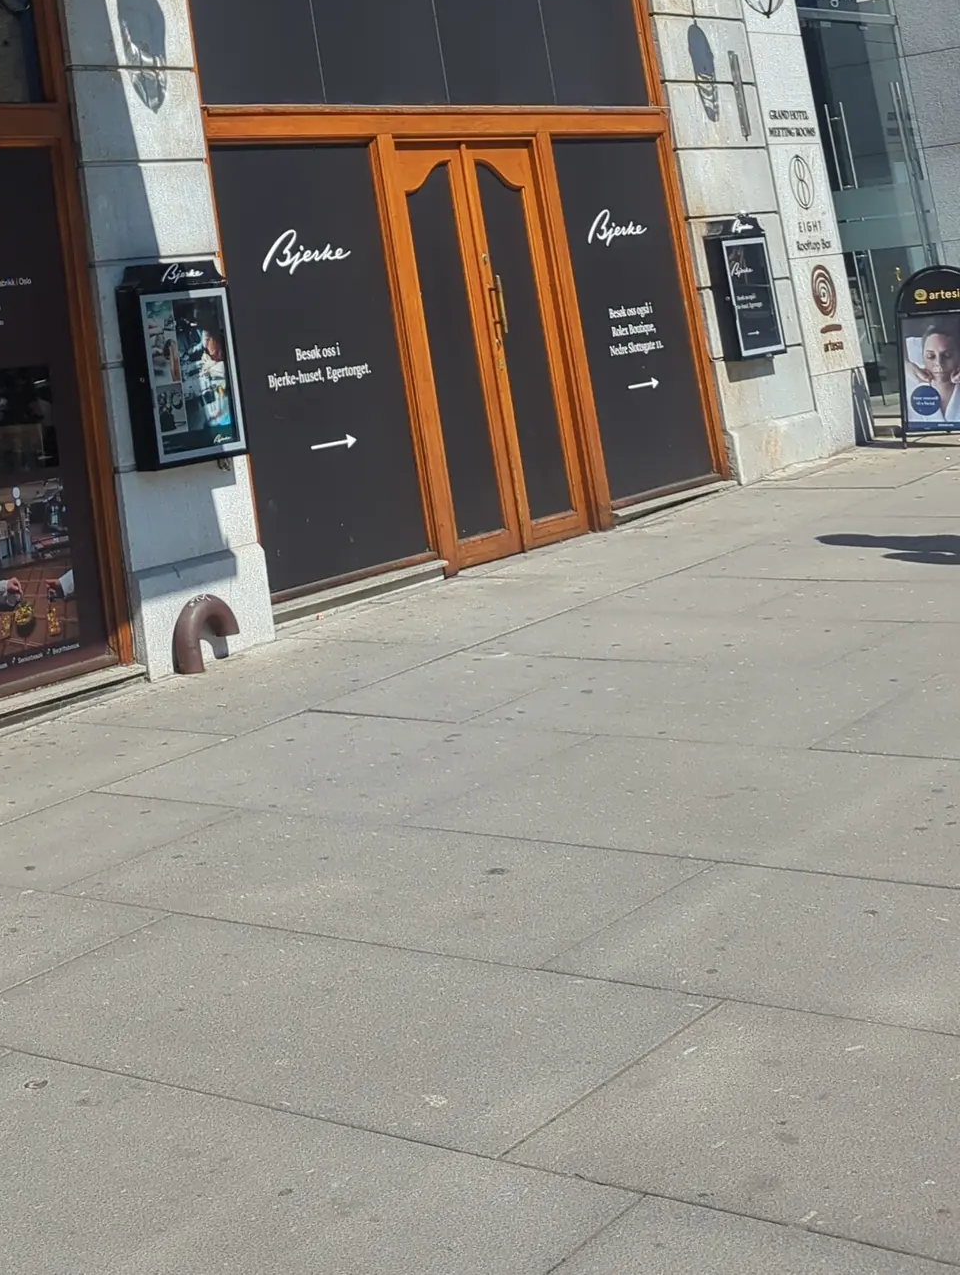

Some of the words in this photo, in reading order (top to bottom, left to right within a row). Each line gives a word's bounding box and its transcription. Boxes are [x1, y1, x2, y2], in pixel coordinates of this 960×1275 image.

[769, 110, 789, 120] GRAND
[789, 110, 809, 120] HOTEL
[587, 209, 647, 246] Bjerke
[798, 220, 822, 233] EIGHT
[262, 229, 351, 275] Bjerke
[161, 263, 204, 284] Bjerke
[18, 277, 32, 286] Oslo
[929, 288, 960, 300] artesi
[627, 307, 636, 317] oss
[648, 302, 653, 313] i
[611, 324, 629, 337] Rolex
[628, 321, 657, 336] Boutique,
[295, 344, 321, 362] Besøk
[321, 345, 336, 358] oss
[335, 342, 341, 356] i
[609, 343, 628, 357] Nedre
[267, 368, 325, 392] Bjerke-huset,
[325, 362, 372, 383] Egertorget.
